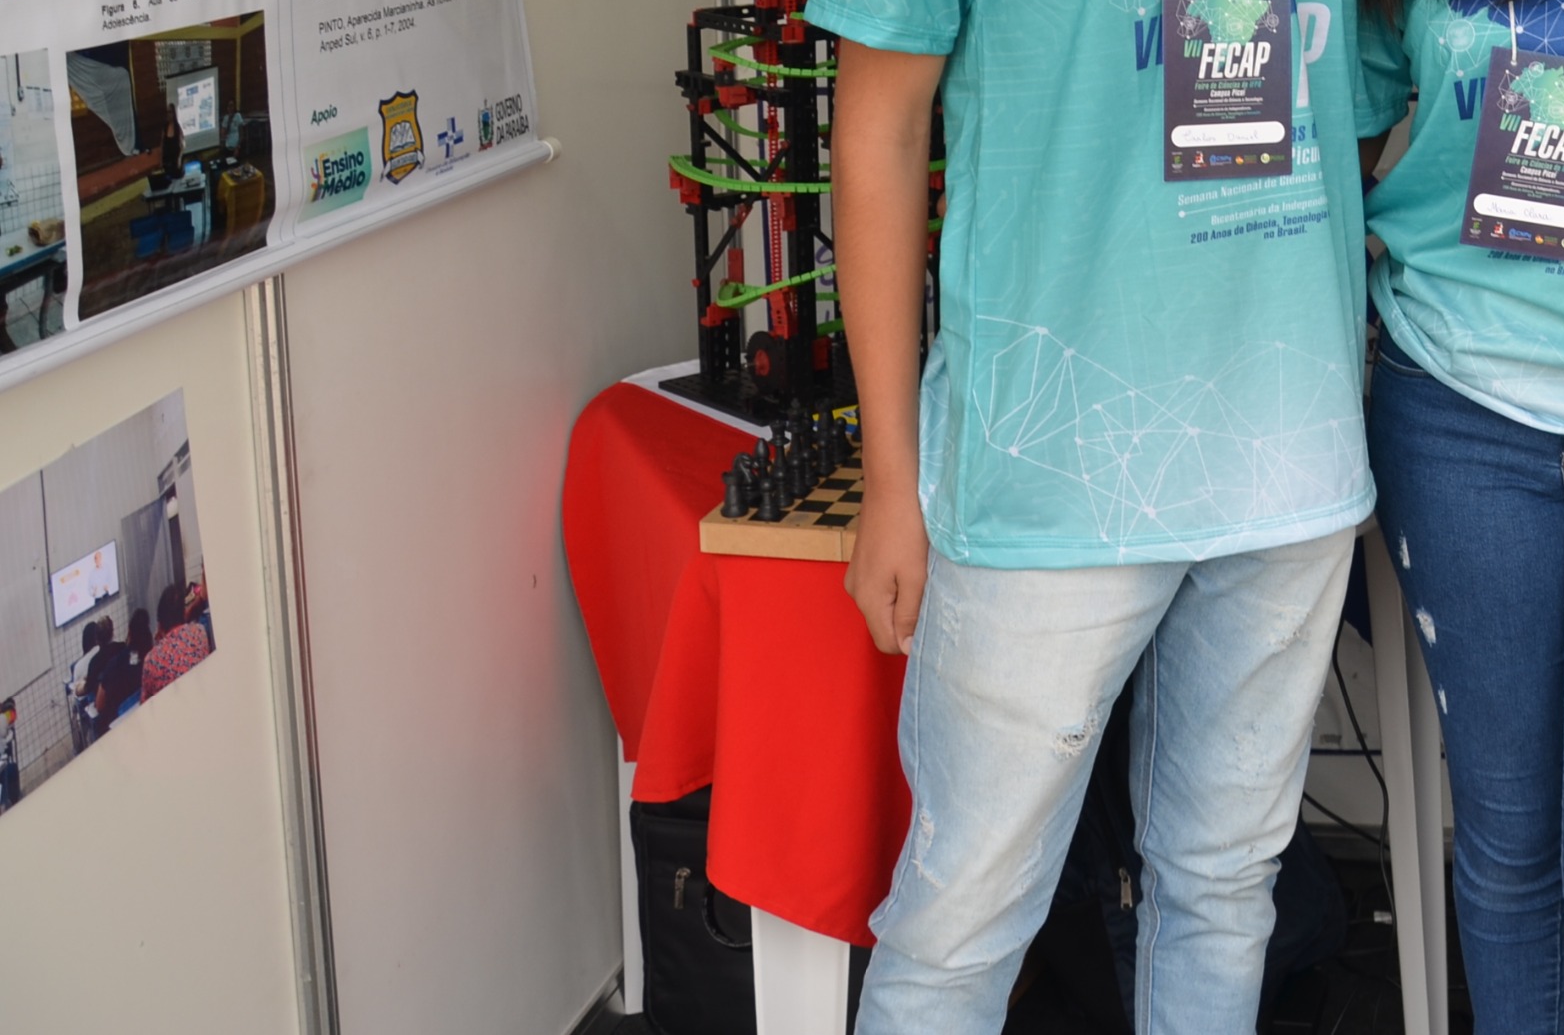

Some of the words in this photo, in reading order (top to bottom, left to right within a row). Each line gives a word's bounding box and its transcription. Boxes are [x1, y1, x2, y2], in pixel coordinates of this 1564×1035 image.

[1184, 39, 1202, 58] VII
[1198, 41, 1271, 79] FECAP
[310, 104, 338, 126] Apoio
[495, 93, 523, 121] GOVERNO
[1500, 113, 1521, 132] VII
[322, 150, 364, 176] Ensino
[321, 169, 366, 200] Médio
[1178, 190, 1218, 206] Semana
[1221, 178, 1262, 196] Nacional
[1264, 178, 1277, 188] de
[1191, 232, 1208, 244] 200
[1210, 227, 1232, 241] Anos
[1234, 224, 1245, 234] de
[1263, 229, 1275, 240] no
[1277, 224, 1307, 239] Brasil.
